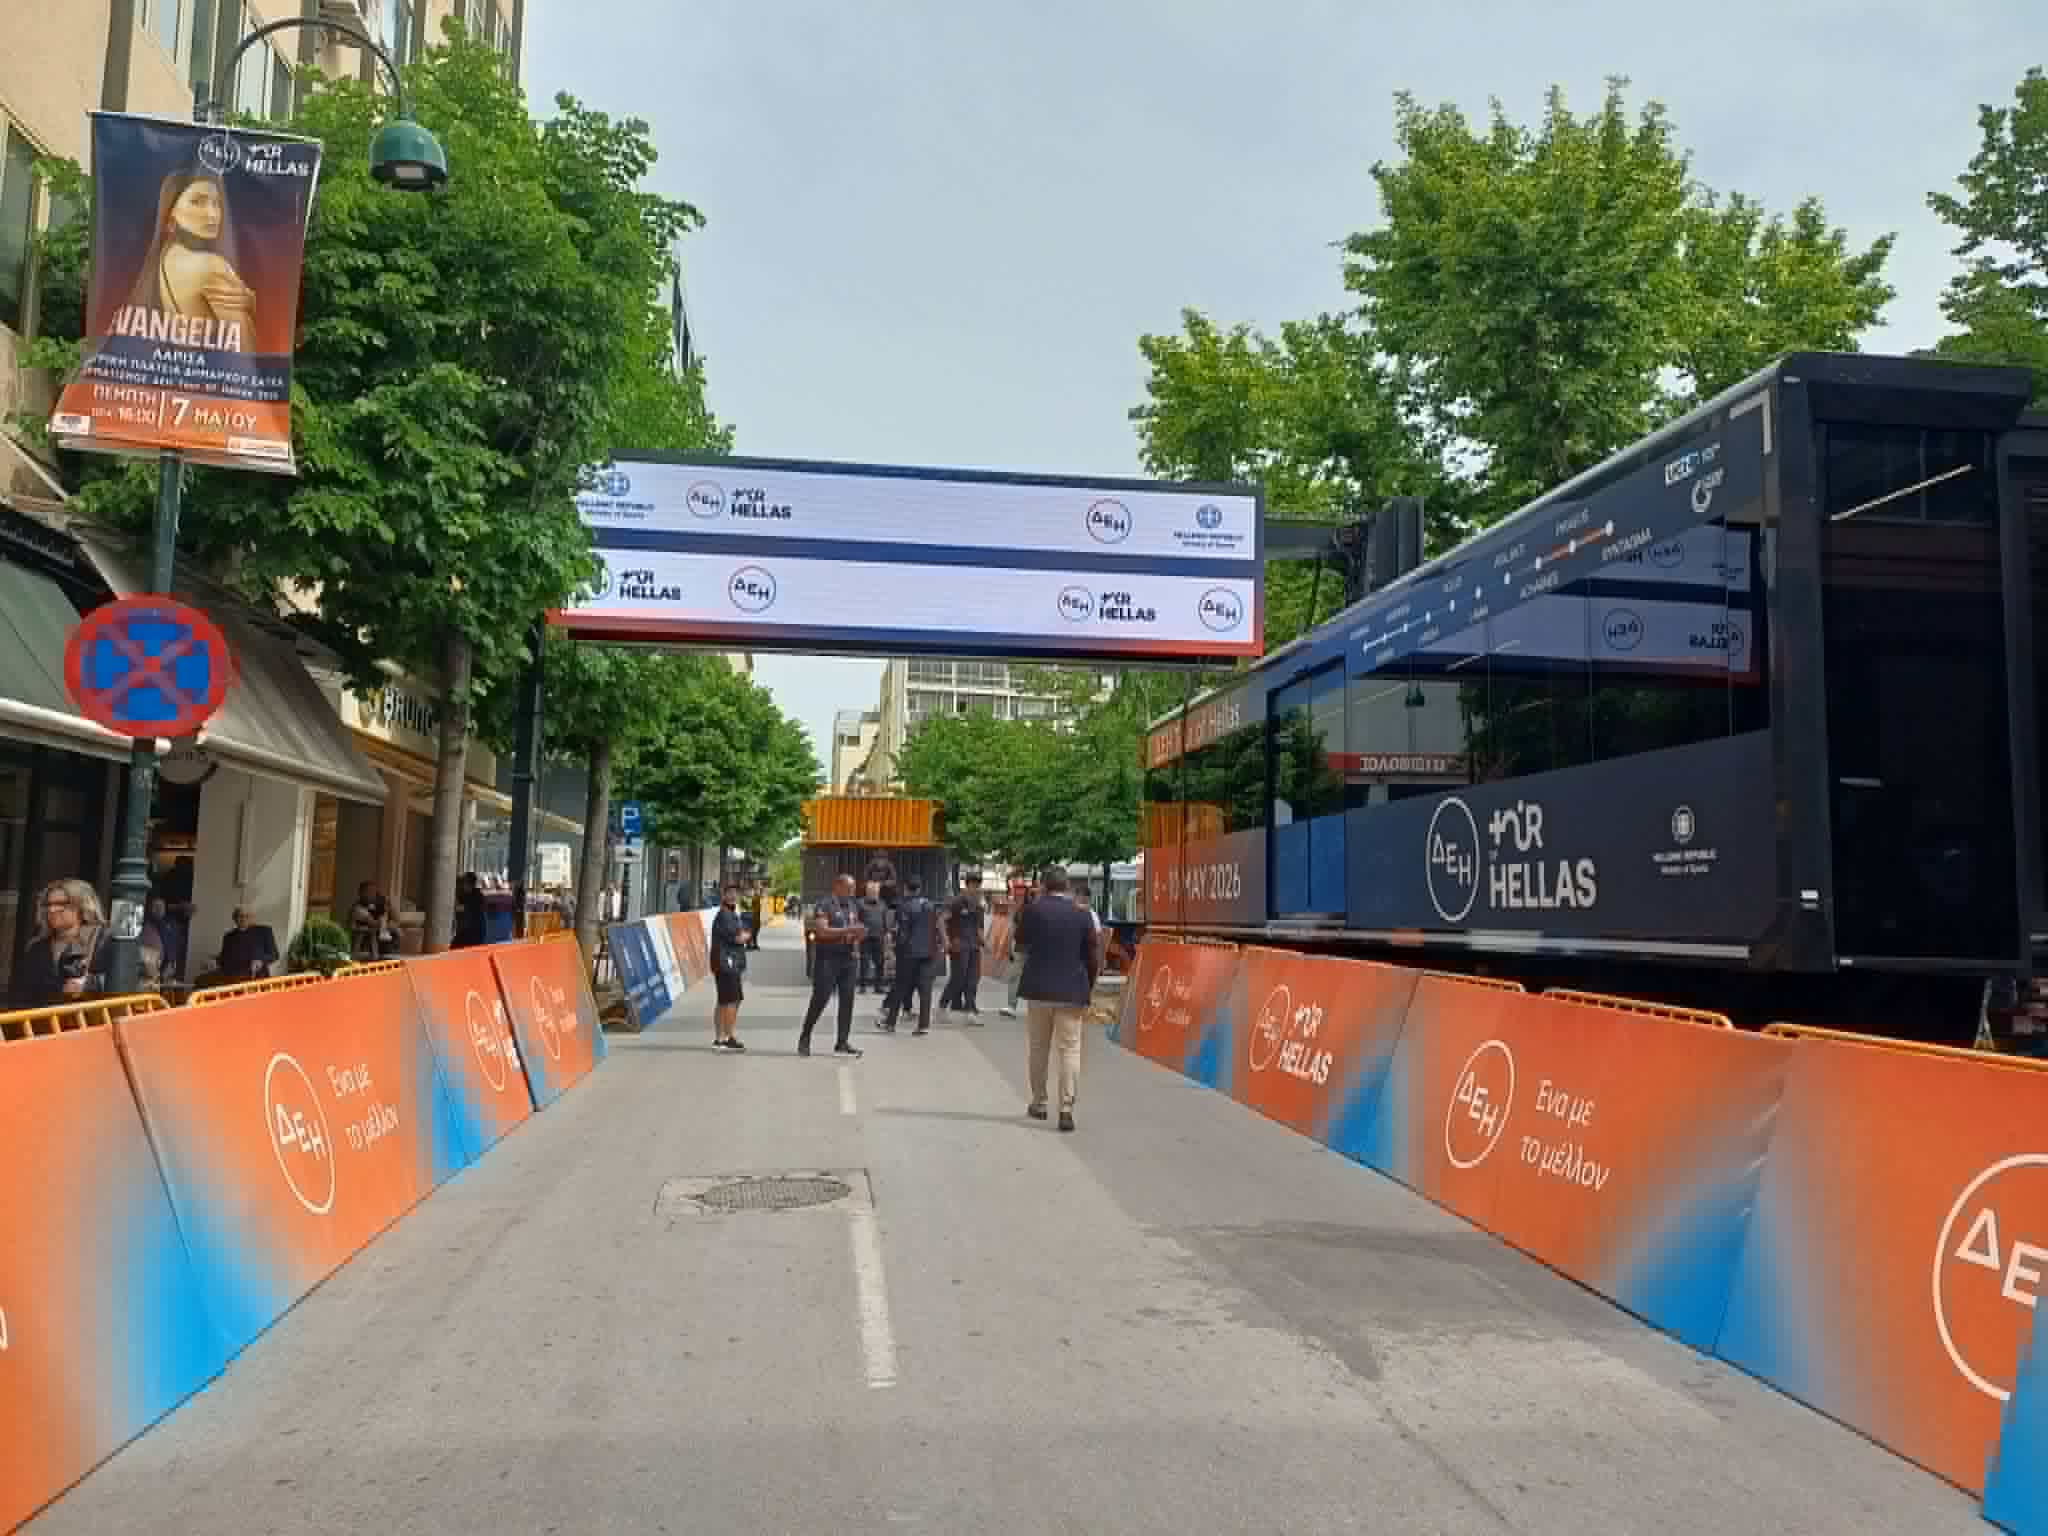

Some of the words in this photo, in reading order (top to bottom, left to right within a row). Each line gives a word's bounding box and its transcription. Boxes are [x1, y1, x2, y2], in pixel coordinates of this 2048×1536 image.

[170, 397, 191, 426] 7
[730, 502, 792, 519] HELLAS
[619, 585, 681, 600] HELLAS
[1099, 606, 1156, 622] HELLAS
[1488, 857, 1598, 909] HELLAS
[1279, 1040, 1333, 1086] HELLAS
[1954, 1207, 2048, 1308] ΔΕ
